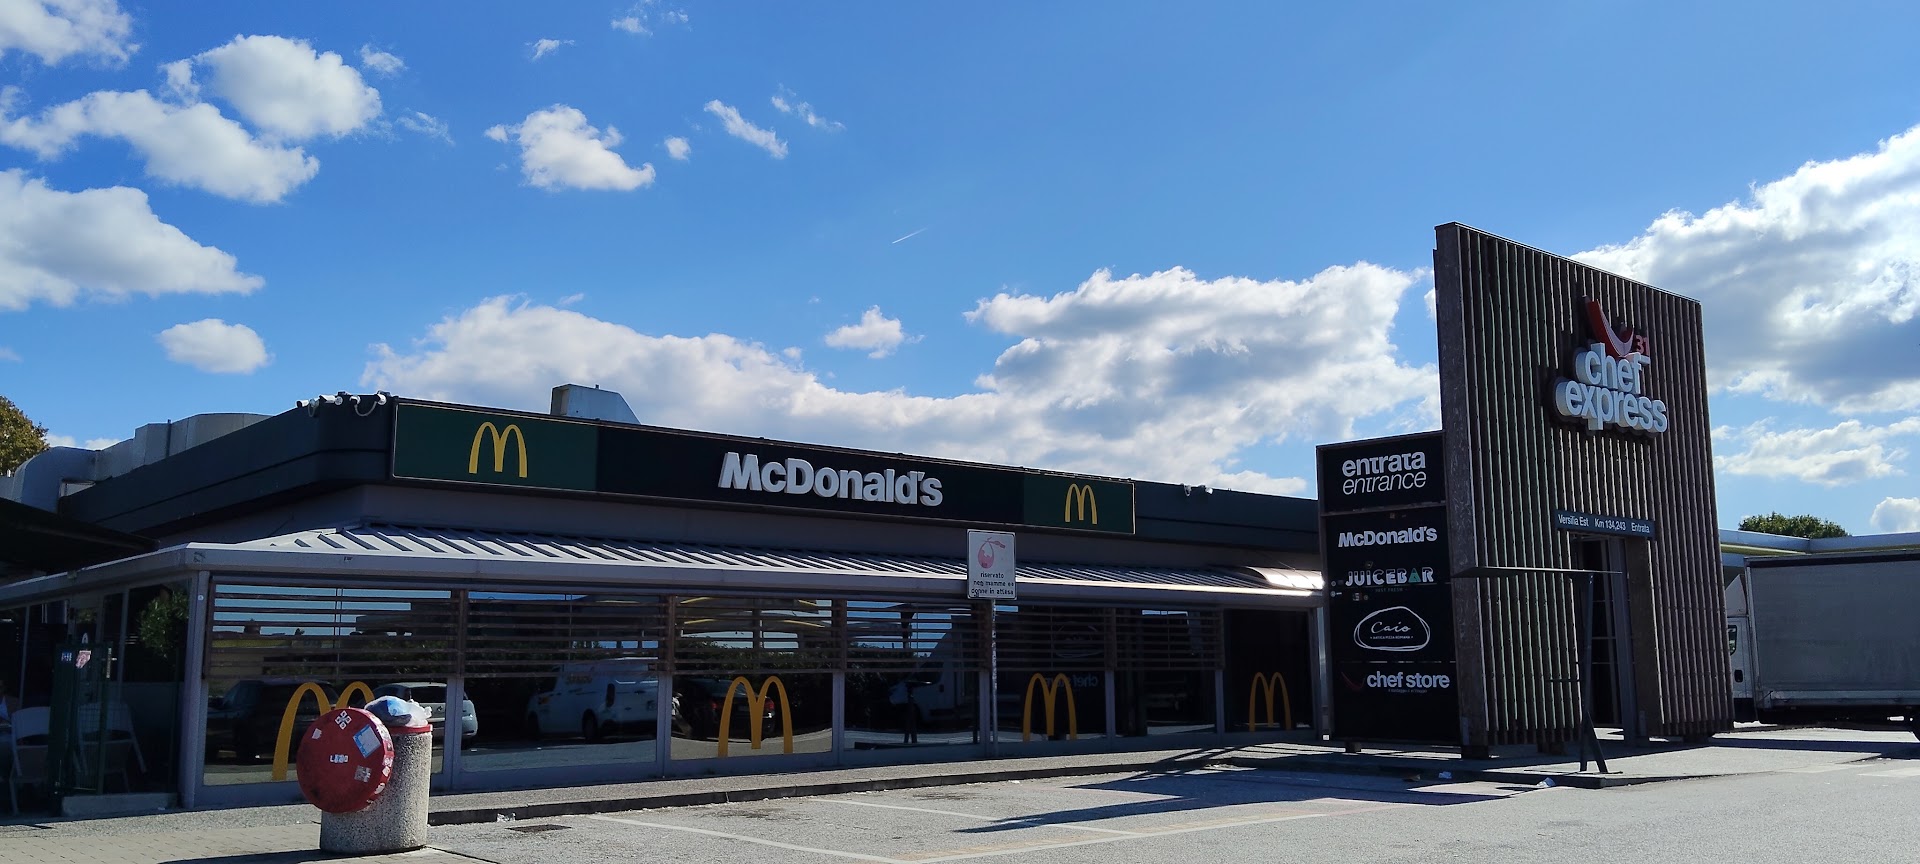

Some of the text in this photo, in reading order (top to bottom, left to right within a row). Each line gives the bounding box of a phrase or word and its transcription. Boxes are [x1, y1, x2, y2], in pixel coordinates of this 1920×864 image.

[1635, 335, 1650, 356] 31
[1576, 343, 1649, 394] chef
[1556, 380, 1668, 433] express
[1342, 451, 1426, 477] entrata
[718, 451, 943, 507] McDonald's
[1343, 471, 1427, 495] entrance
[1558, 514, 1651, 534] Versilia Est Km 134,243 Entrata
[1338, 526, 1438, 548] McDonald's
[980, 571, 1005, 579] riservato
[1371, 621, 1411, 634] Caio
[1367, 671, 1450, 688] chef store
